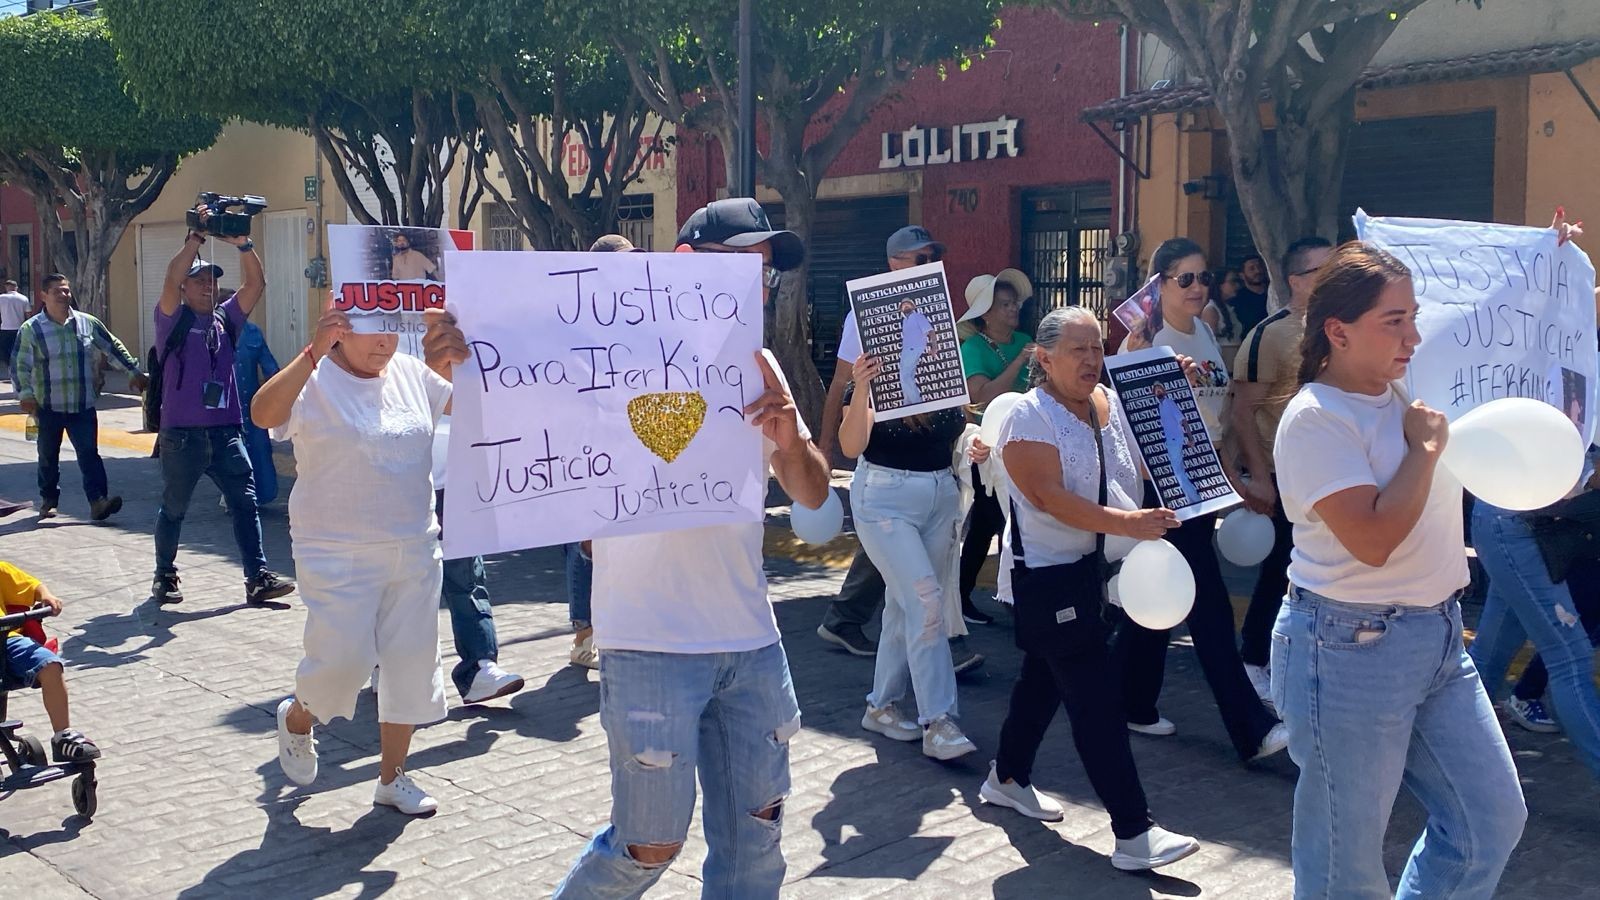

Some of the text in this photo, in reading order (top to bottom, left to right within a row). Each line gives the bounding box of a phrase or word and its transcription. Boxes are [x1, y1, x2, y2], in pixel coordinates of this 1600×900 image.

[335, 282, 445, 311] JUSTIC
[549, 261, 747, 326] Justicia
[856, 277, 939, 301] #JUSTICIAPARAIFER
[467, 340, 577, 393] Para
[471, 429, 617, 503] Justicia
[593, 465, 739, 521] Justicia
